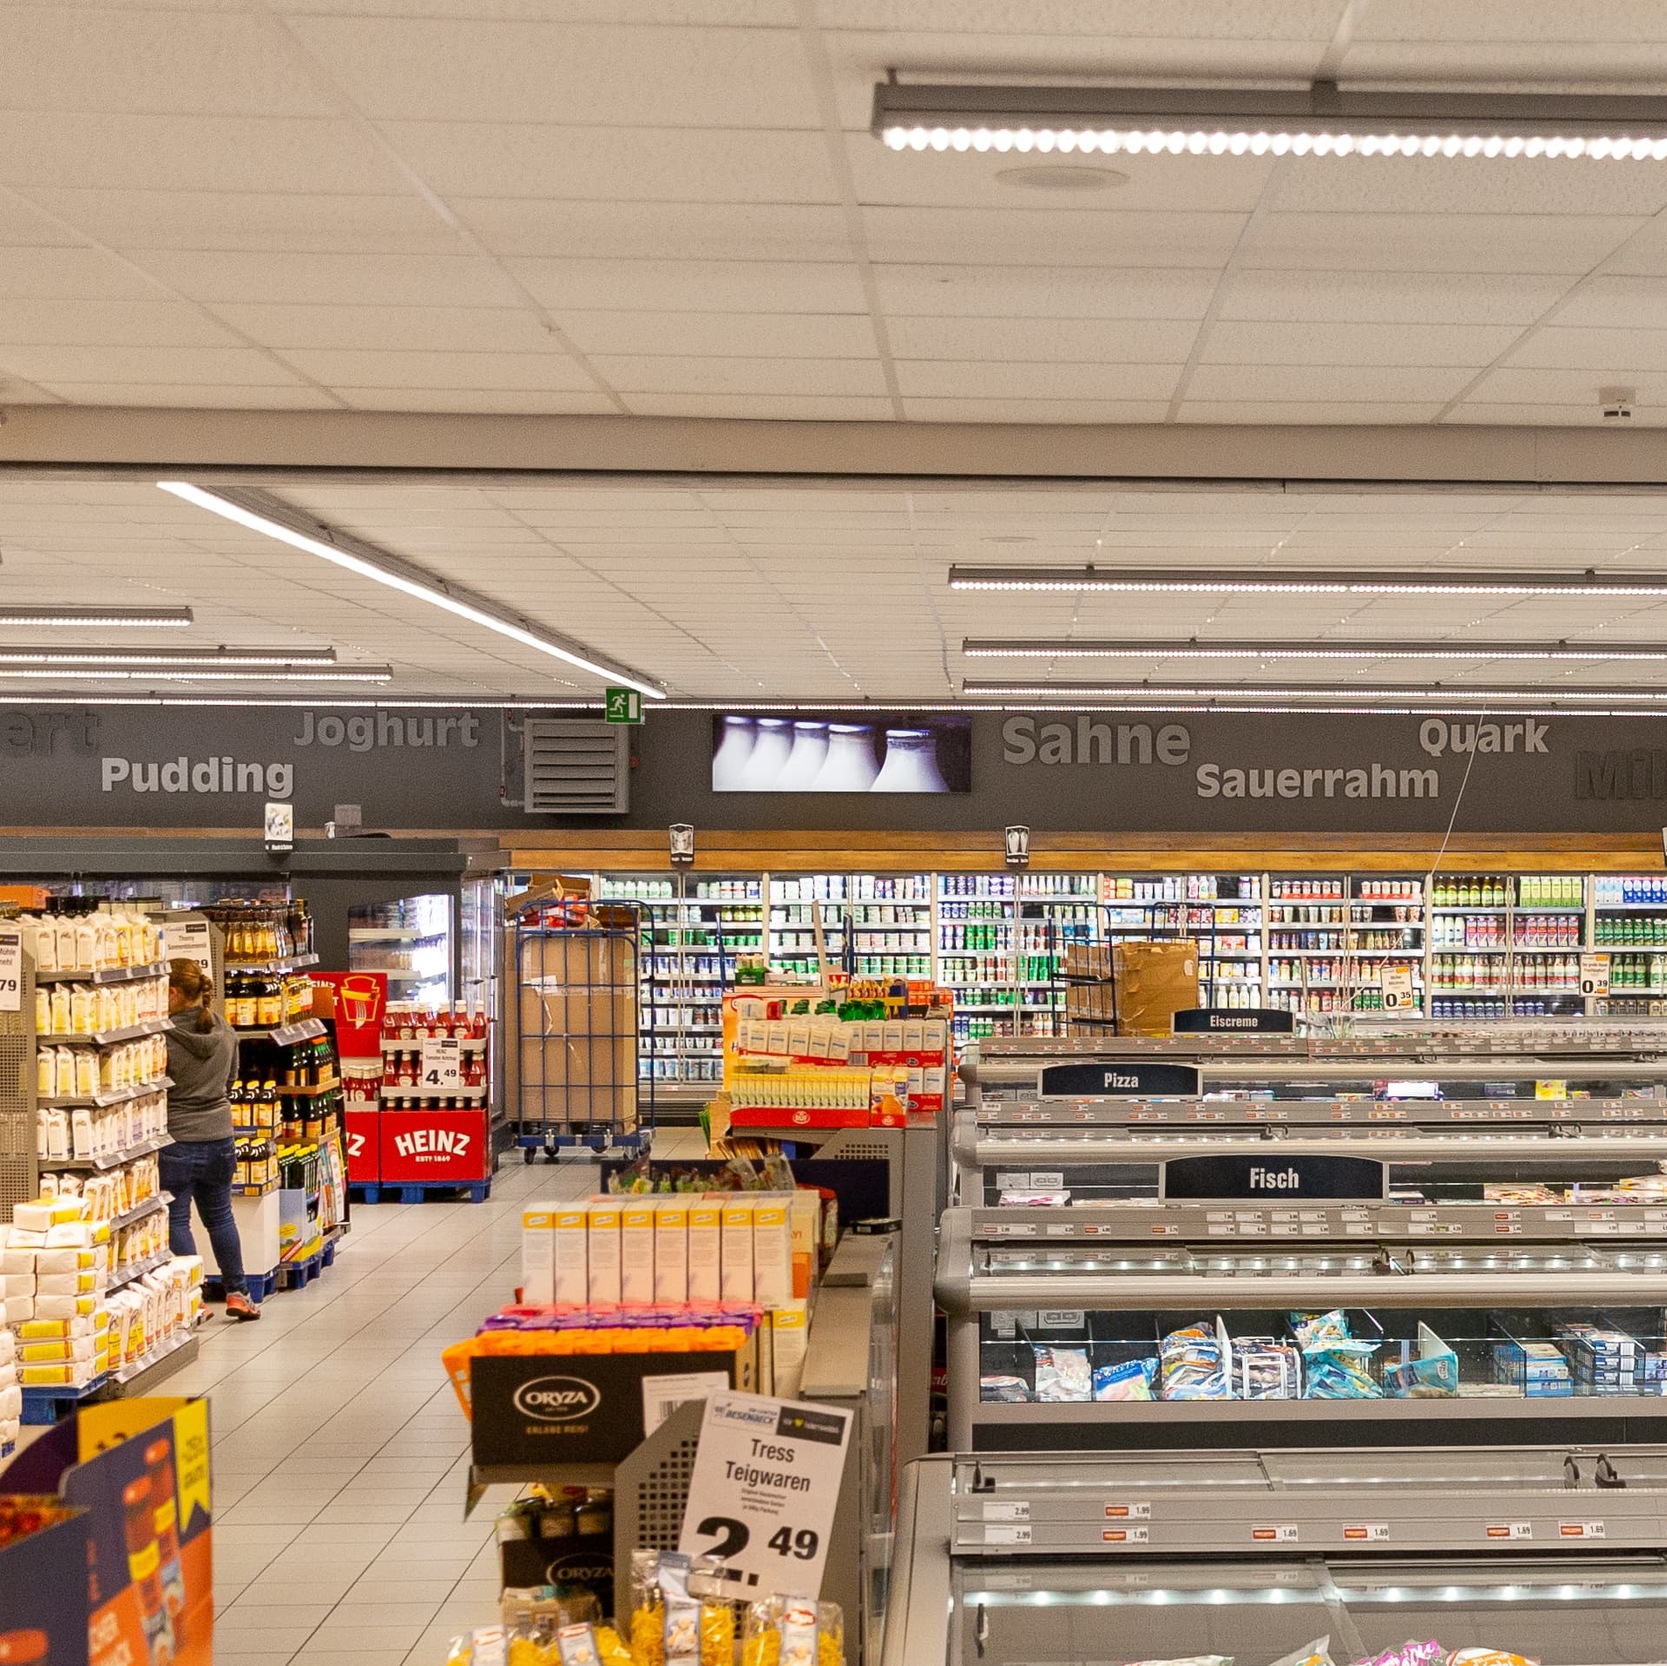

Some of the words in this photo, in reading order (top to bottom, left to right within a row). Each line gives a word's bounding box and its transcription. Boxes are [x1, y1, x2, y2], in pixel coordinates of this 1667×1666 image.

[294, 711, 480, 752] Joghurt
[1002, 715, 1190, 765] Sahne
[1419, 718, 1549, 755] Quark
[102, 756, 294, 799] Pudding
[1196, 763, 1439, 799] Sauerrahm
[1209, 1015, 1258, 1028] Eiscreme
[1104, 1072, 1139, 1089] Pizza
[394, 1129, 471, 1157] HEINZ
[1249, 1167, 1300, 1191] Fisch
[525, 1389, 588, 1405] ORYZA
[750, 1438, 796, 1463] Tress
[725, 1461, 811, 1492] Teigwaren
[1135, 1505, 1151, 1514] 1.99
[1015, 1530, 1032, 1540] 2.99
[1133, 1530, 1149, 1539] 1.99
